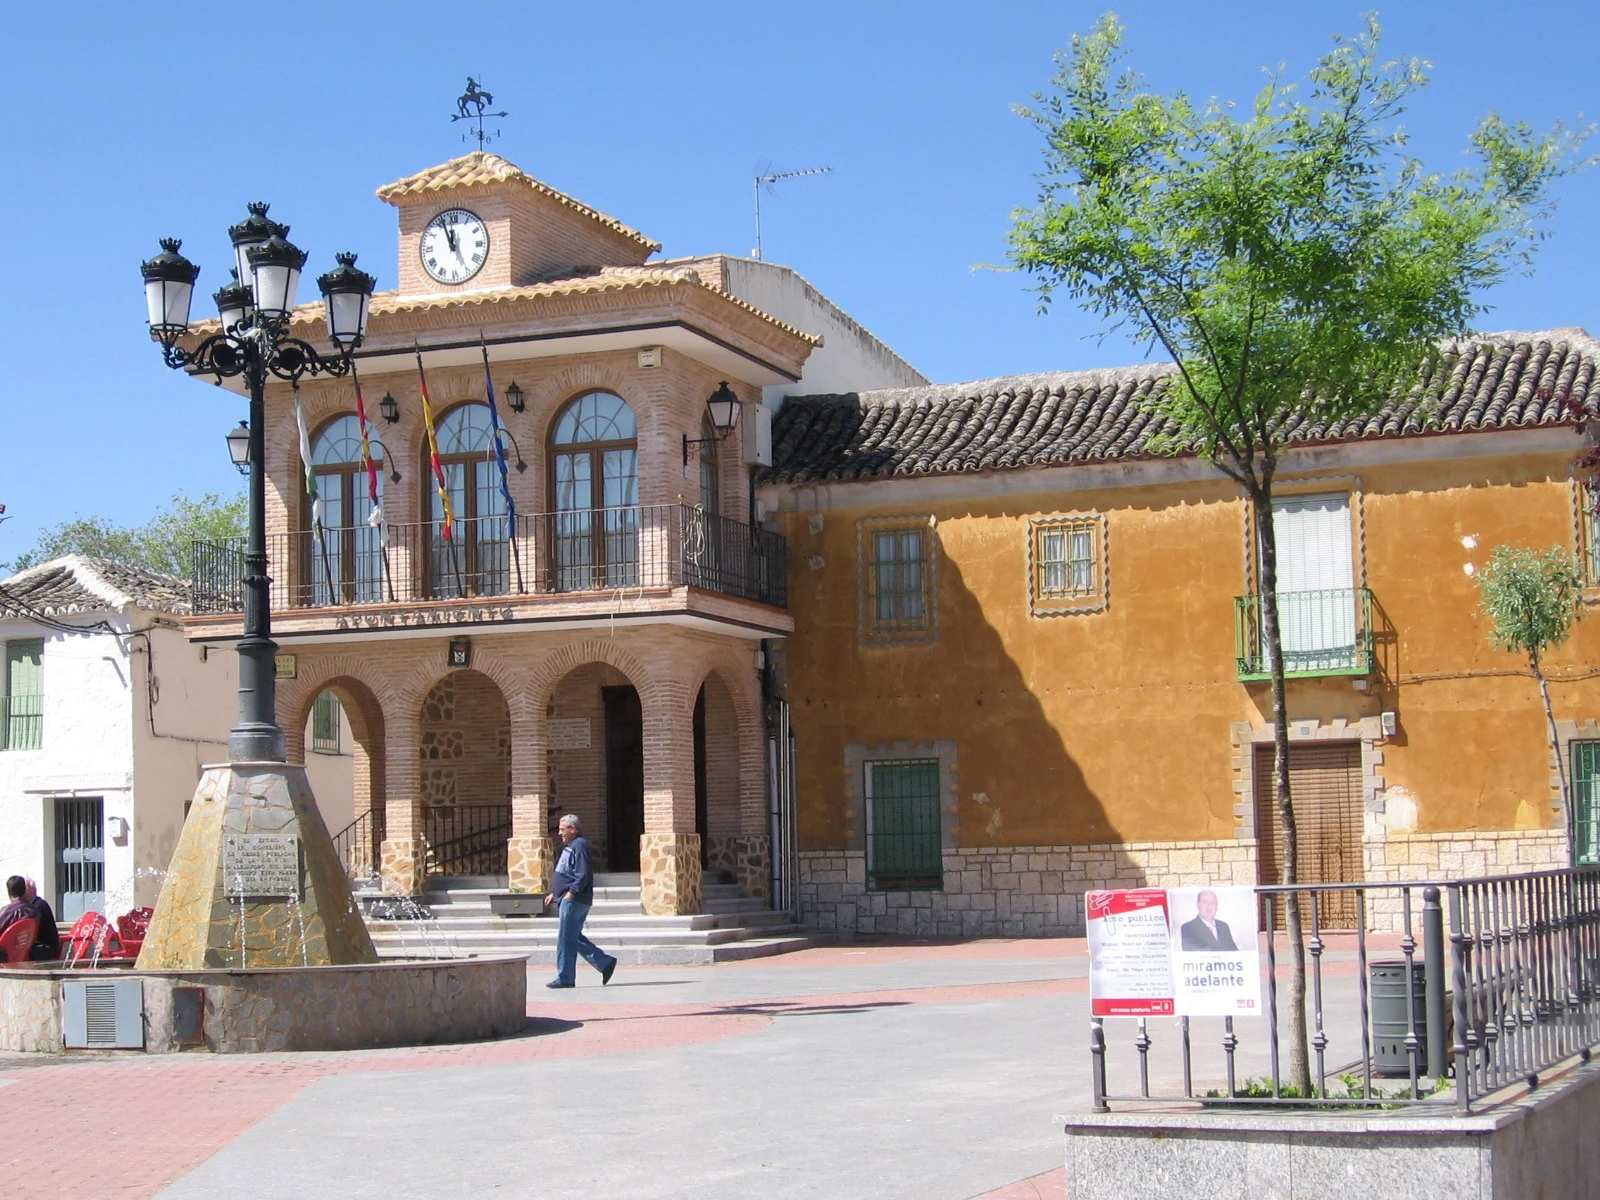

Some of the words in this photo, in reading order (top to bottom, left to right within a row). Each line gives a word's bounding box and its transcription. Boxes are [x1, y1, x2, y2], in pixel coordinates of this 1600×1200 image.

[336, 606, 514, 629] AYUNTAMIENTO
[1128, 914, 1165, 924] público
[1183, 960, 1244, 972] miramos
[1184, 974, 1244, 987] adelante
